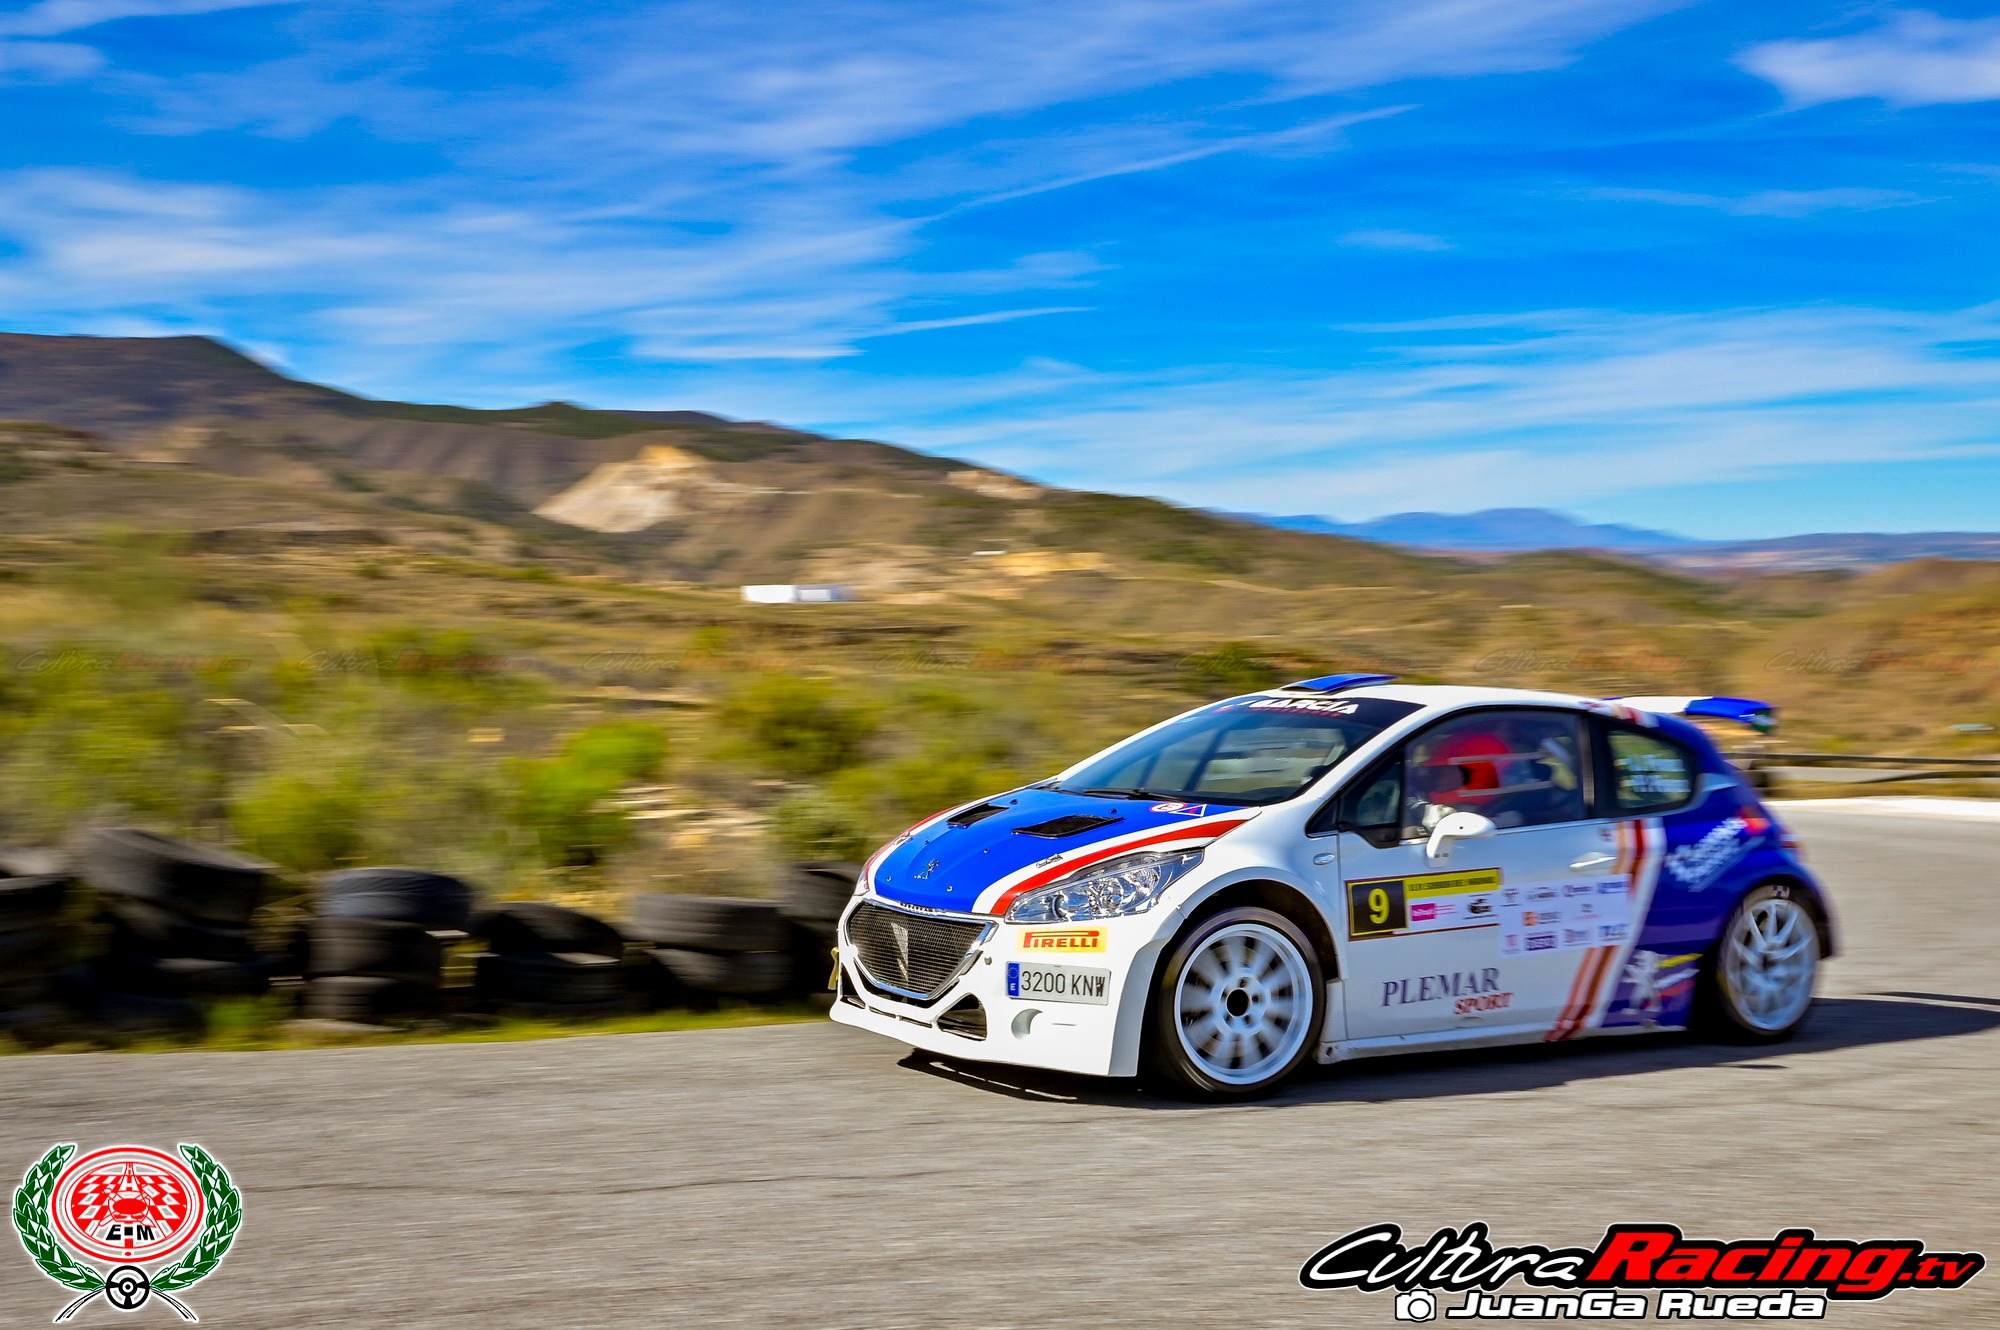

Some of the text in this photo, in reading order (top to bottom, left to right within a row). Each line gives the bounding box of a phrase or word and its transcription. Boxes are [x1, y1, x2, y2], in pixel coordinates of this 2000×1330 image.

[1368, 888, 1390, 924] 9
[1023, 930, 1100, 948] PIRELLI
[1010, 983, 1017, 991] E
[1021, 970, 1066, 994] 3200
[1381, 967, 1501, 1007] PLEMAR
